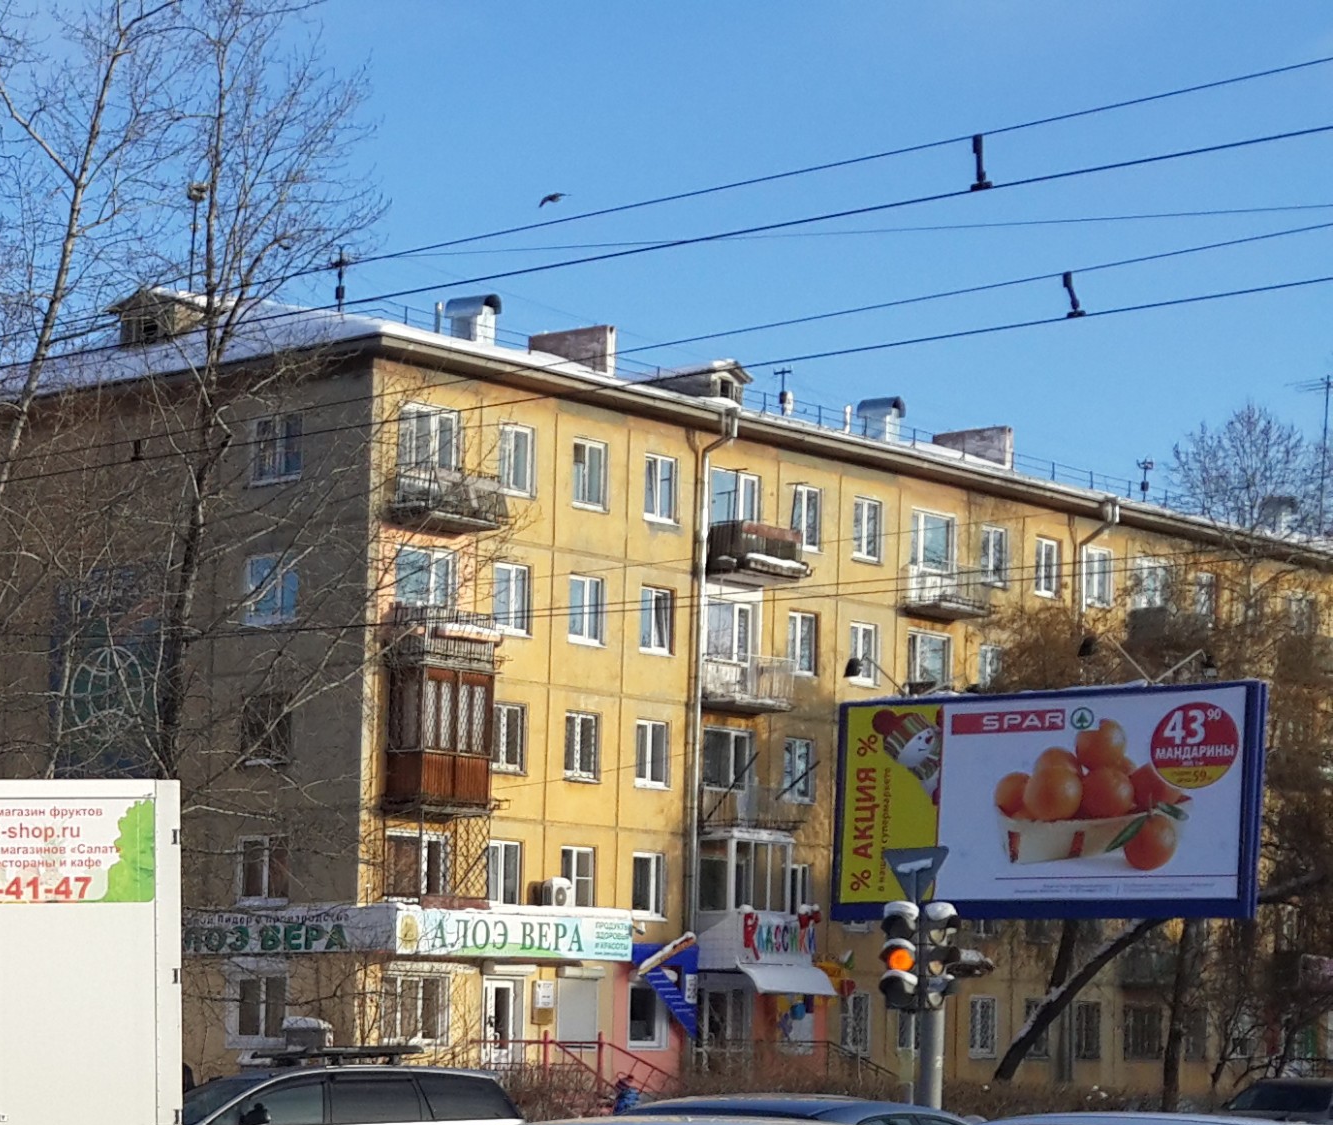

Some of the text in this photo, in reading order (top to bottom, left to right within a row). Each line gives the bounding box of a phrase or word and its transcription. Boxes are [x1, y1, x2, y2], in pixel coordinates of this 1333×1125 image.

[983, 712, 1063, 730] SPAR
[1163, 709, 1206, 745] 43
[1155, 744, 1235, 760] МАНДАРИНЫ
[49, 806, 103, 820] фруктов
[853, 767, 880, 860] АКЦИЯ
[0, 845, 66, 857] магазинов
[59, 860, 67, 869] и
[70, 857, 102, 871] кафе
[261, 923, 348, 950] ВЕРА
[431, 918, 584, 952] АЛОЭ ВЕРА
